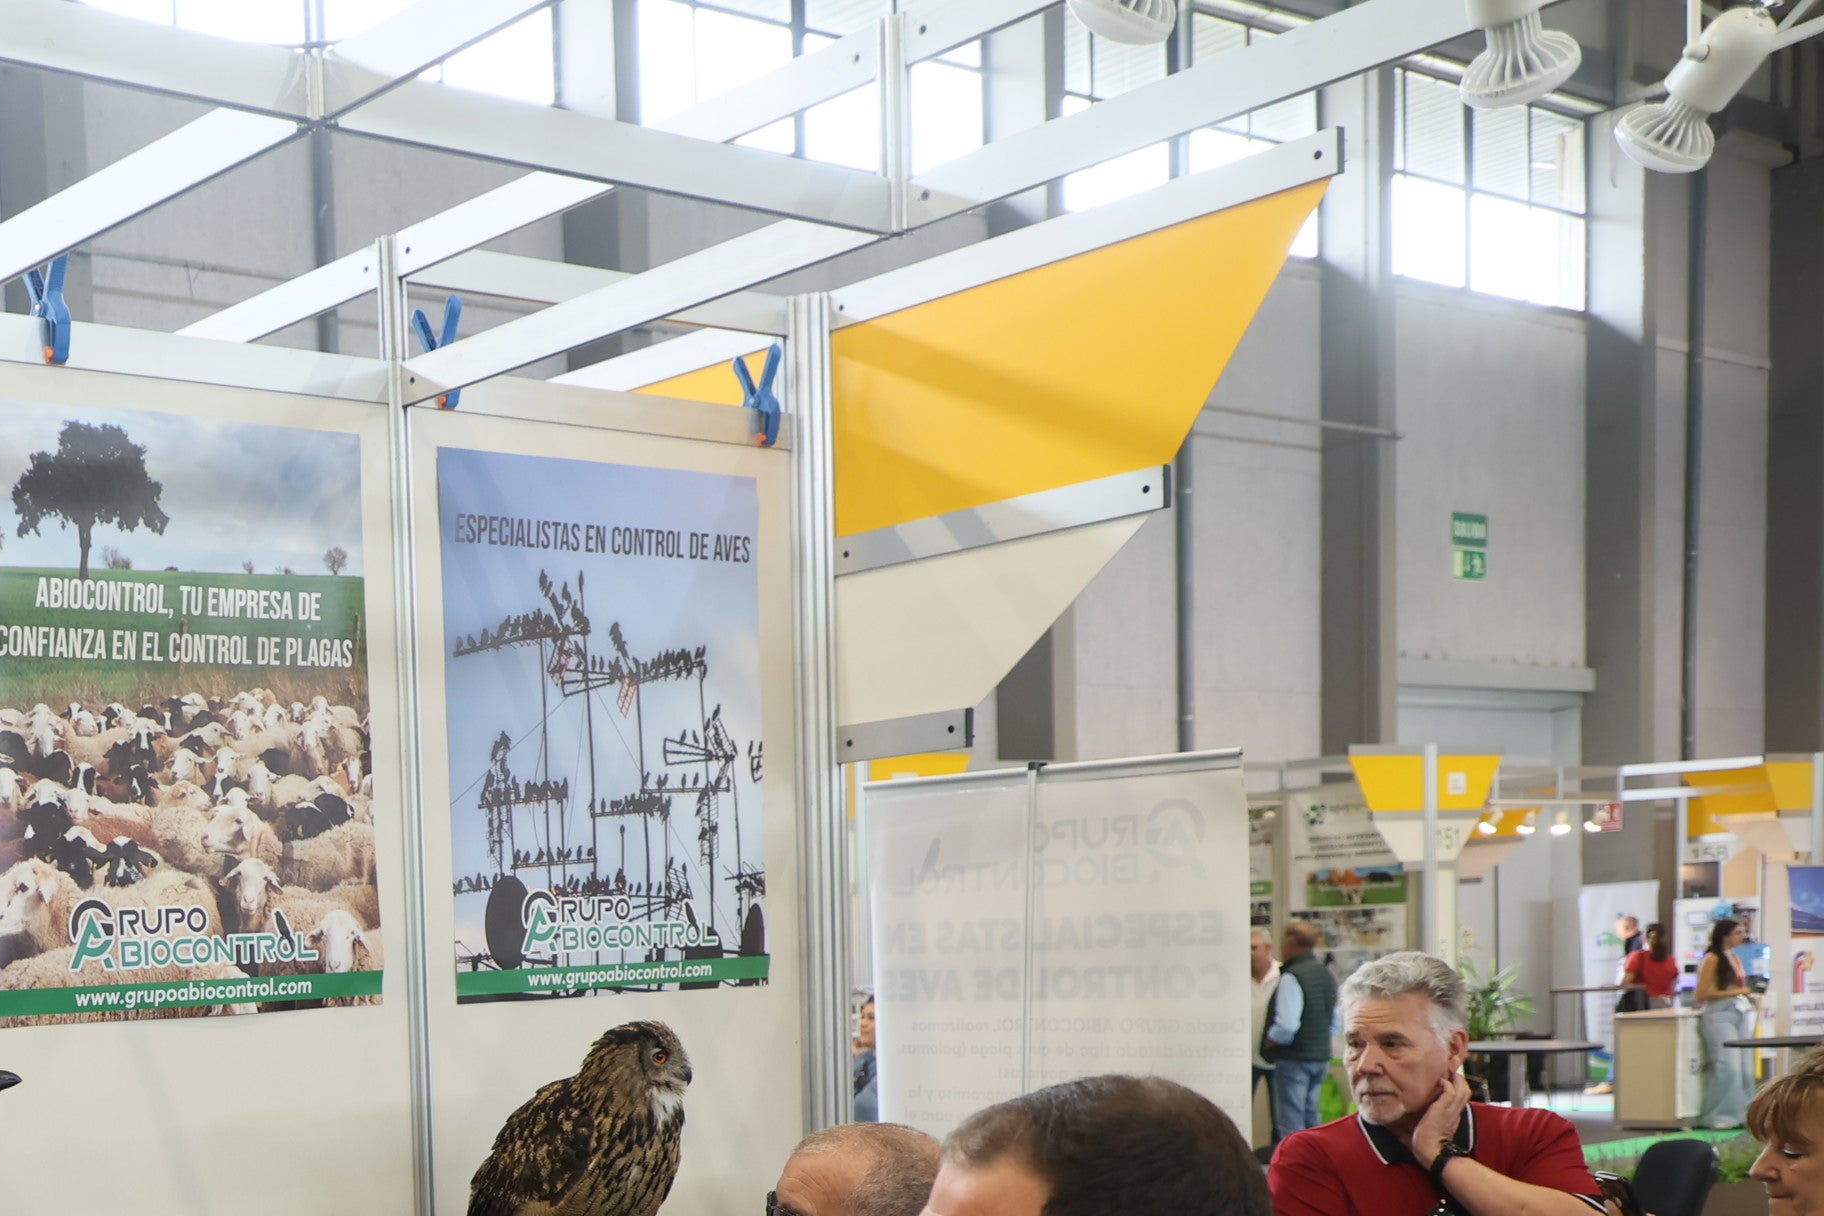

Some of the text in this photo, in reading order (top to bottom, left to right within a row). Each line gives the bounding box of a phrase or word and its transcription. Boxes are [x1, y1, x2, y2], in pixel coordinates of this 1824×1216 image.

[454, 513, 751, 563] ESPECIALISTAS EN CONTROL DE AVES
[35, 576, 321, 621] ABIOCONTROL, TU EMPRESA DE
[112, 630, 137, 661] EN
[142, 632, 163, 662] EL
[169, 632, 252, 665] CONTROL
[257, 636, 280, 666] DE
[285, 637, 353, 668] PLAGAS
[71, 898, 207, 938] GRUPO
[522, 903, 718, 953] ABIOCONTROL
[523, 890, 631, 928] GRUPO
[70, 914, 319, 969] ABIOCONTROL
[76, 977, 312, 1009] www.grupoabiocontrol.com
[528, 963, 712, 988] www.grupoabiocontrol.com
